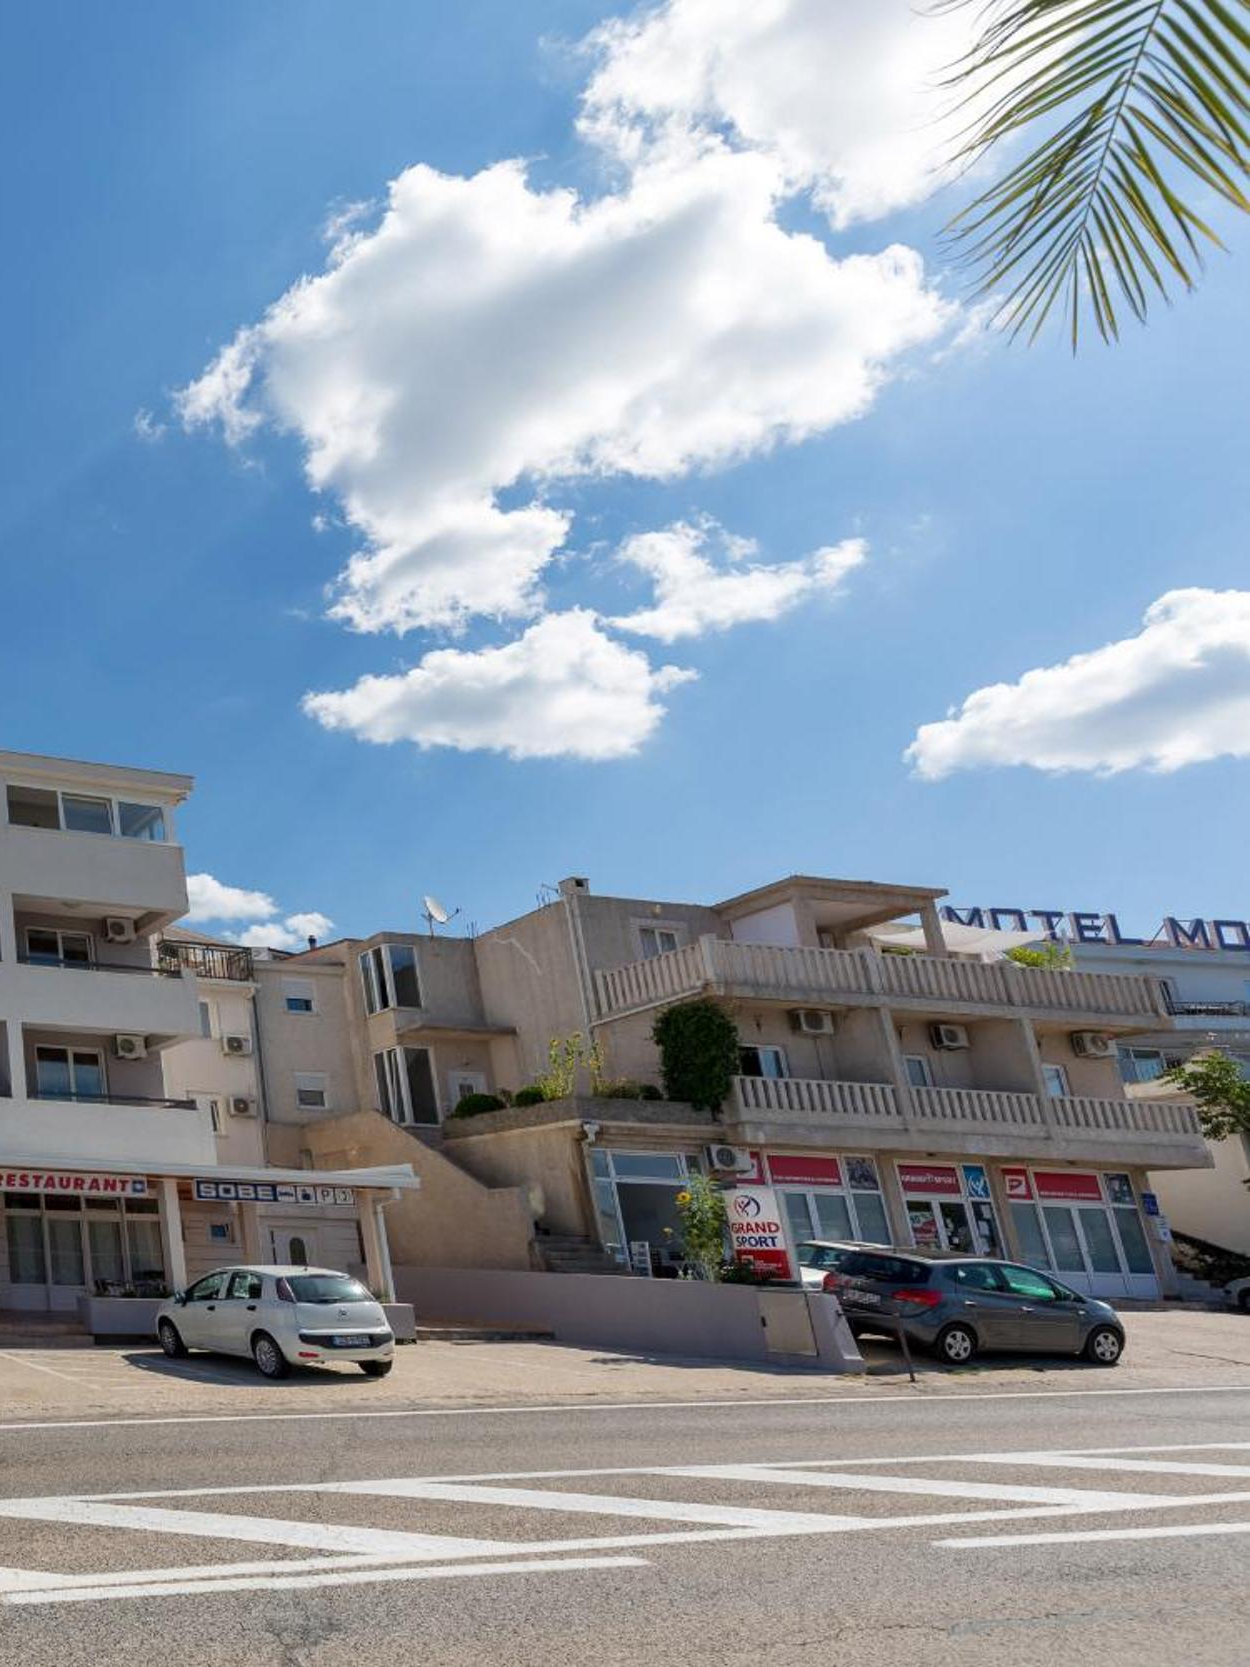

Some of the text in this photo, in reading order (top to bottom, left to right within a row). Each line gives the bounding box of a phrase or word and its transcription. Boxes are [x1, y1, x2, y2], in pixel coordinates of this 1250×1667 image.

[939, 905, 1143, 944] MOTEL
[200, 1182, 274, 1200] SOBE
[731, 1222, 780, 1234] GRAND
[736, 1236, 778, 1247] SPORT
